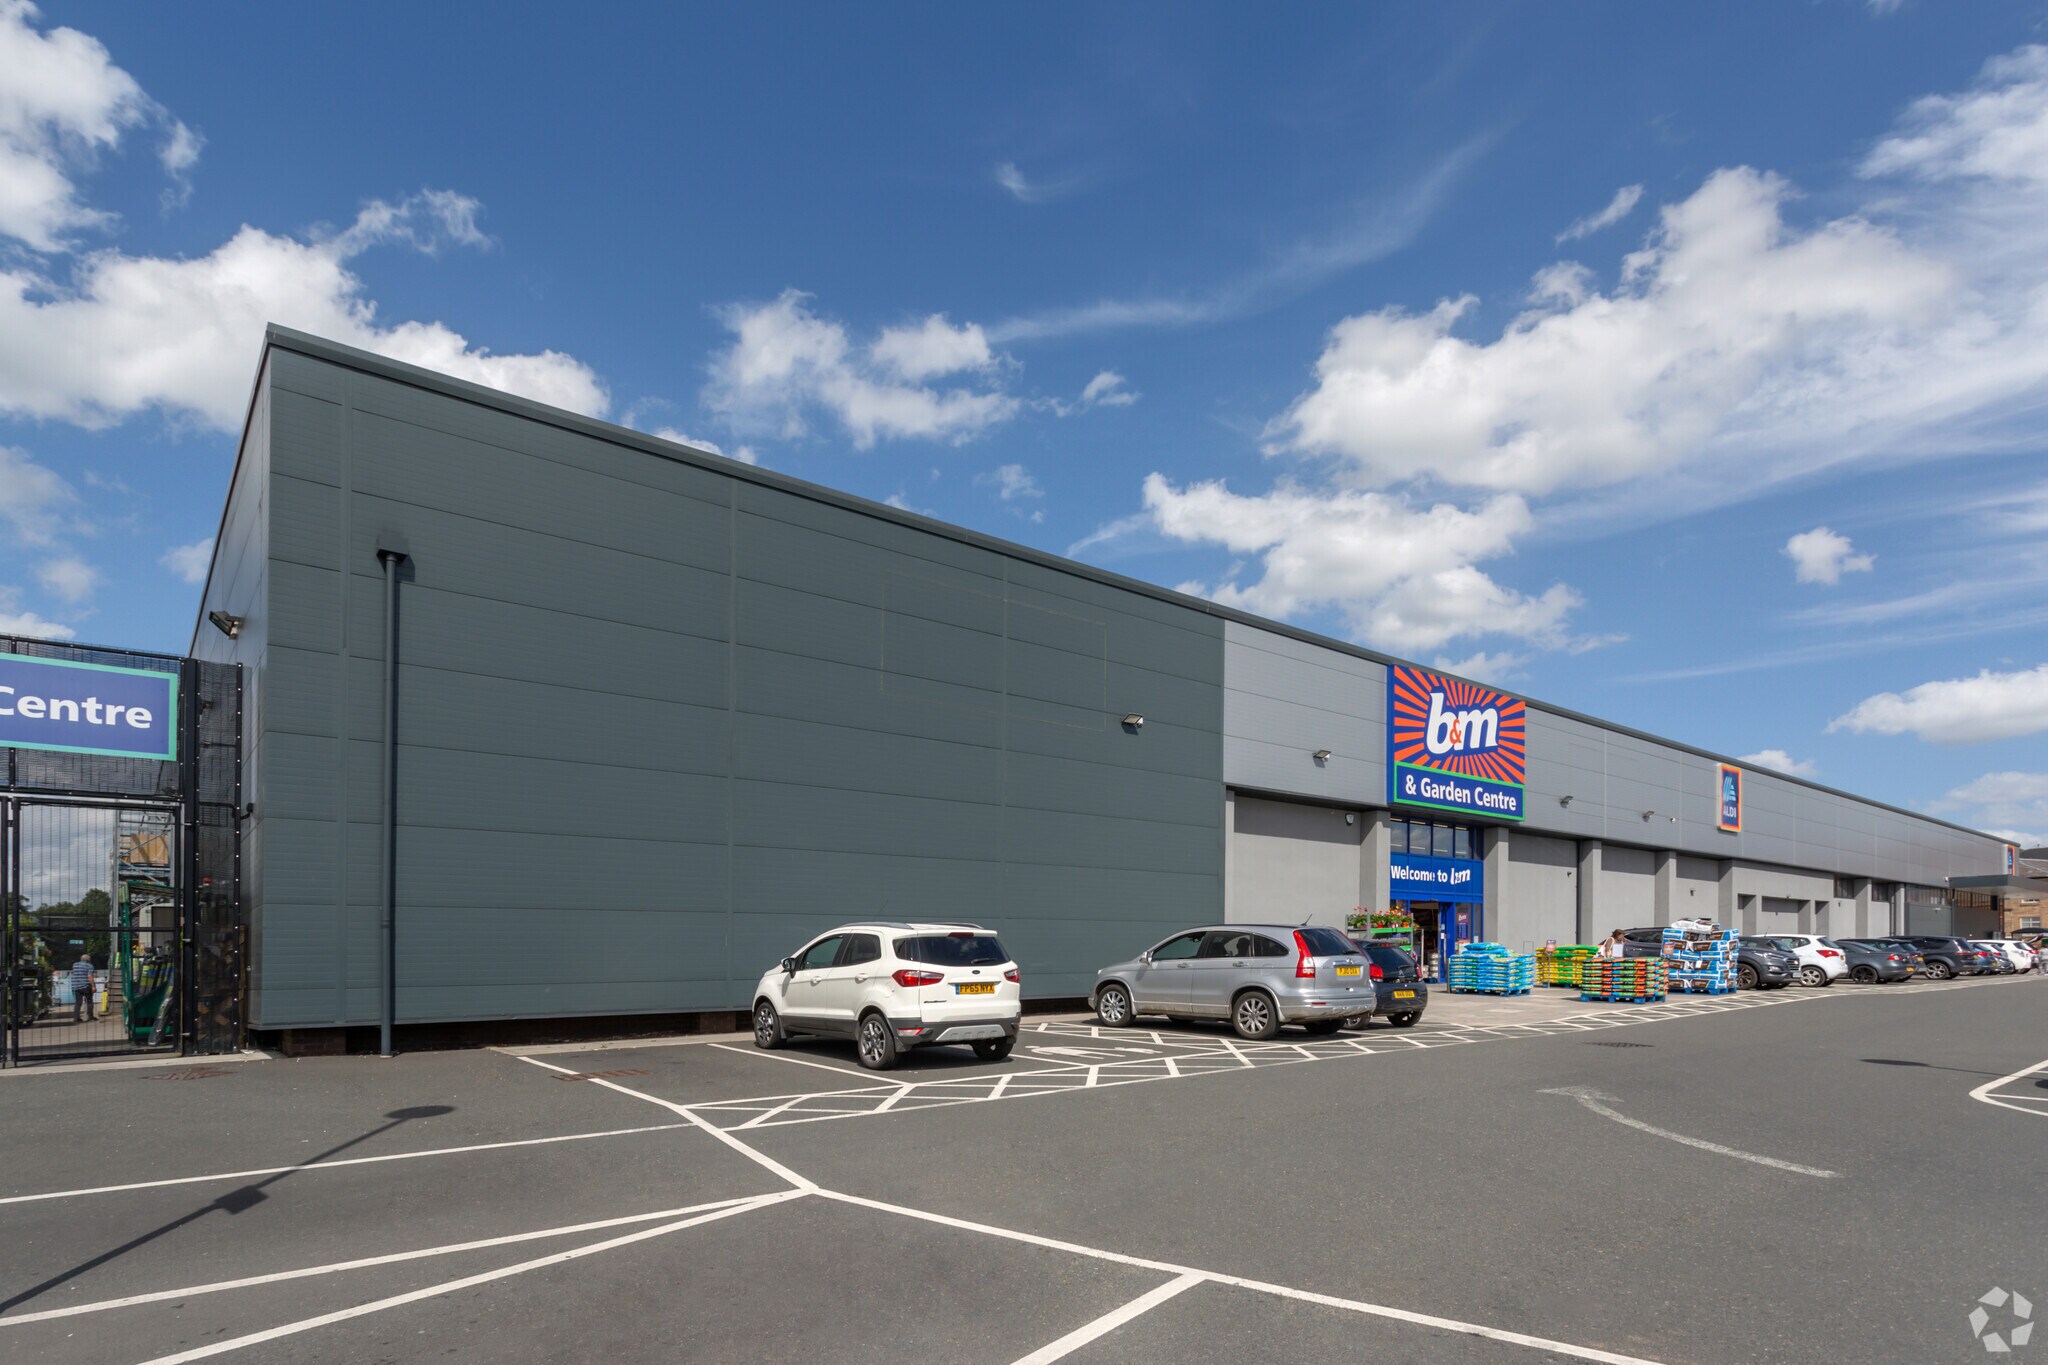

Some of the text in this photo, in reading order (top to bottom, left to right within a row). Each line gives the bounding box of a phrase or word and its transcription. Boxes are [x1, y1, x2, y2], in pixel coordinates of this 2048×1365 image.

[1426, 692, 1498, 755] b&m
[1405, 774, 1517, 812] & Garden Centre
[1722, 804, 1737, 818] ALDI
[1390, 865, 1436, 882] Welcome
[1437, 869, 1448, 883] to
[960, 983, 994, 993] FP65 NYX
